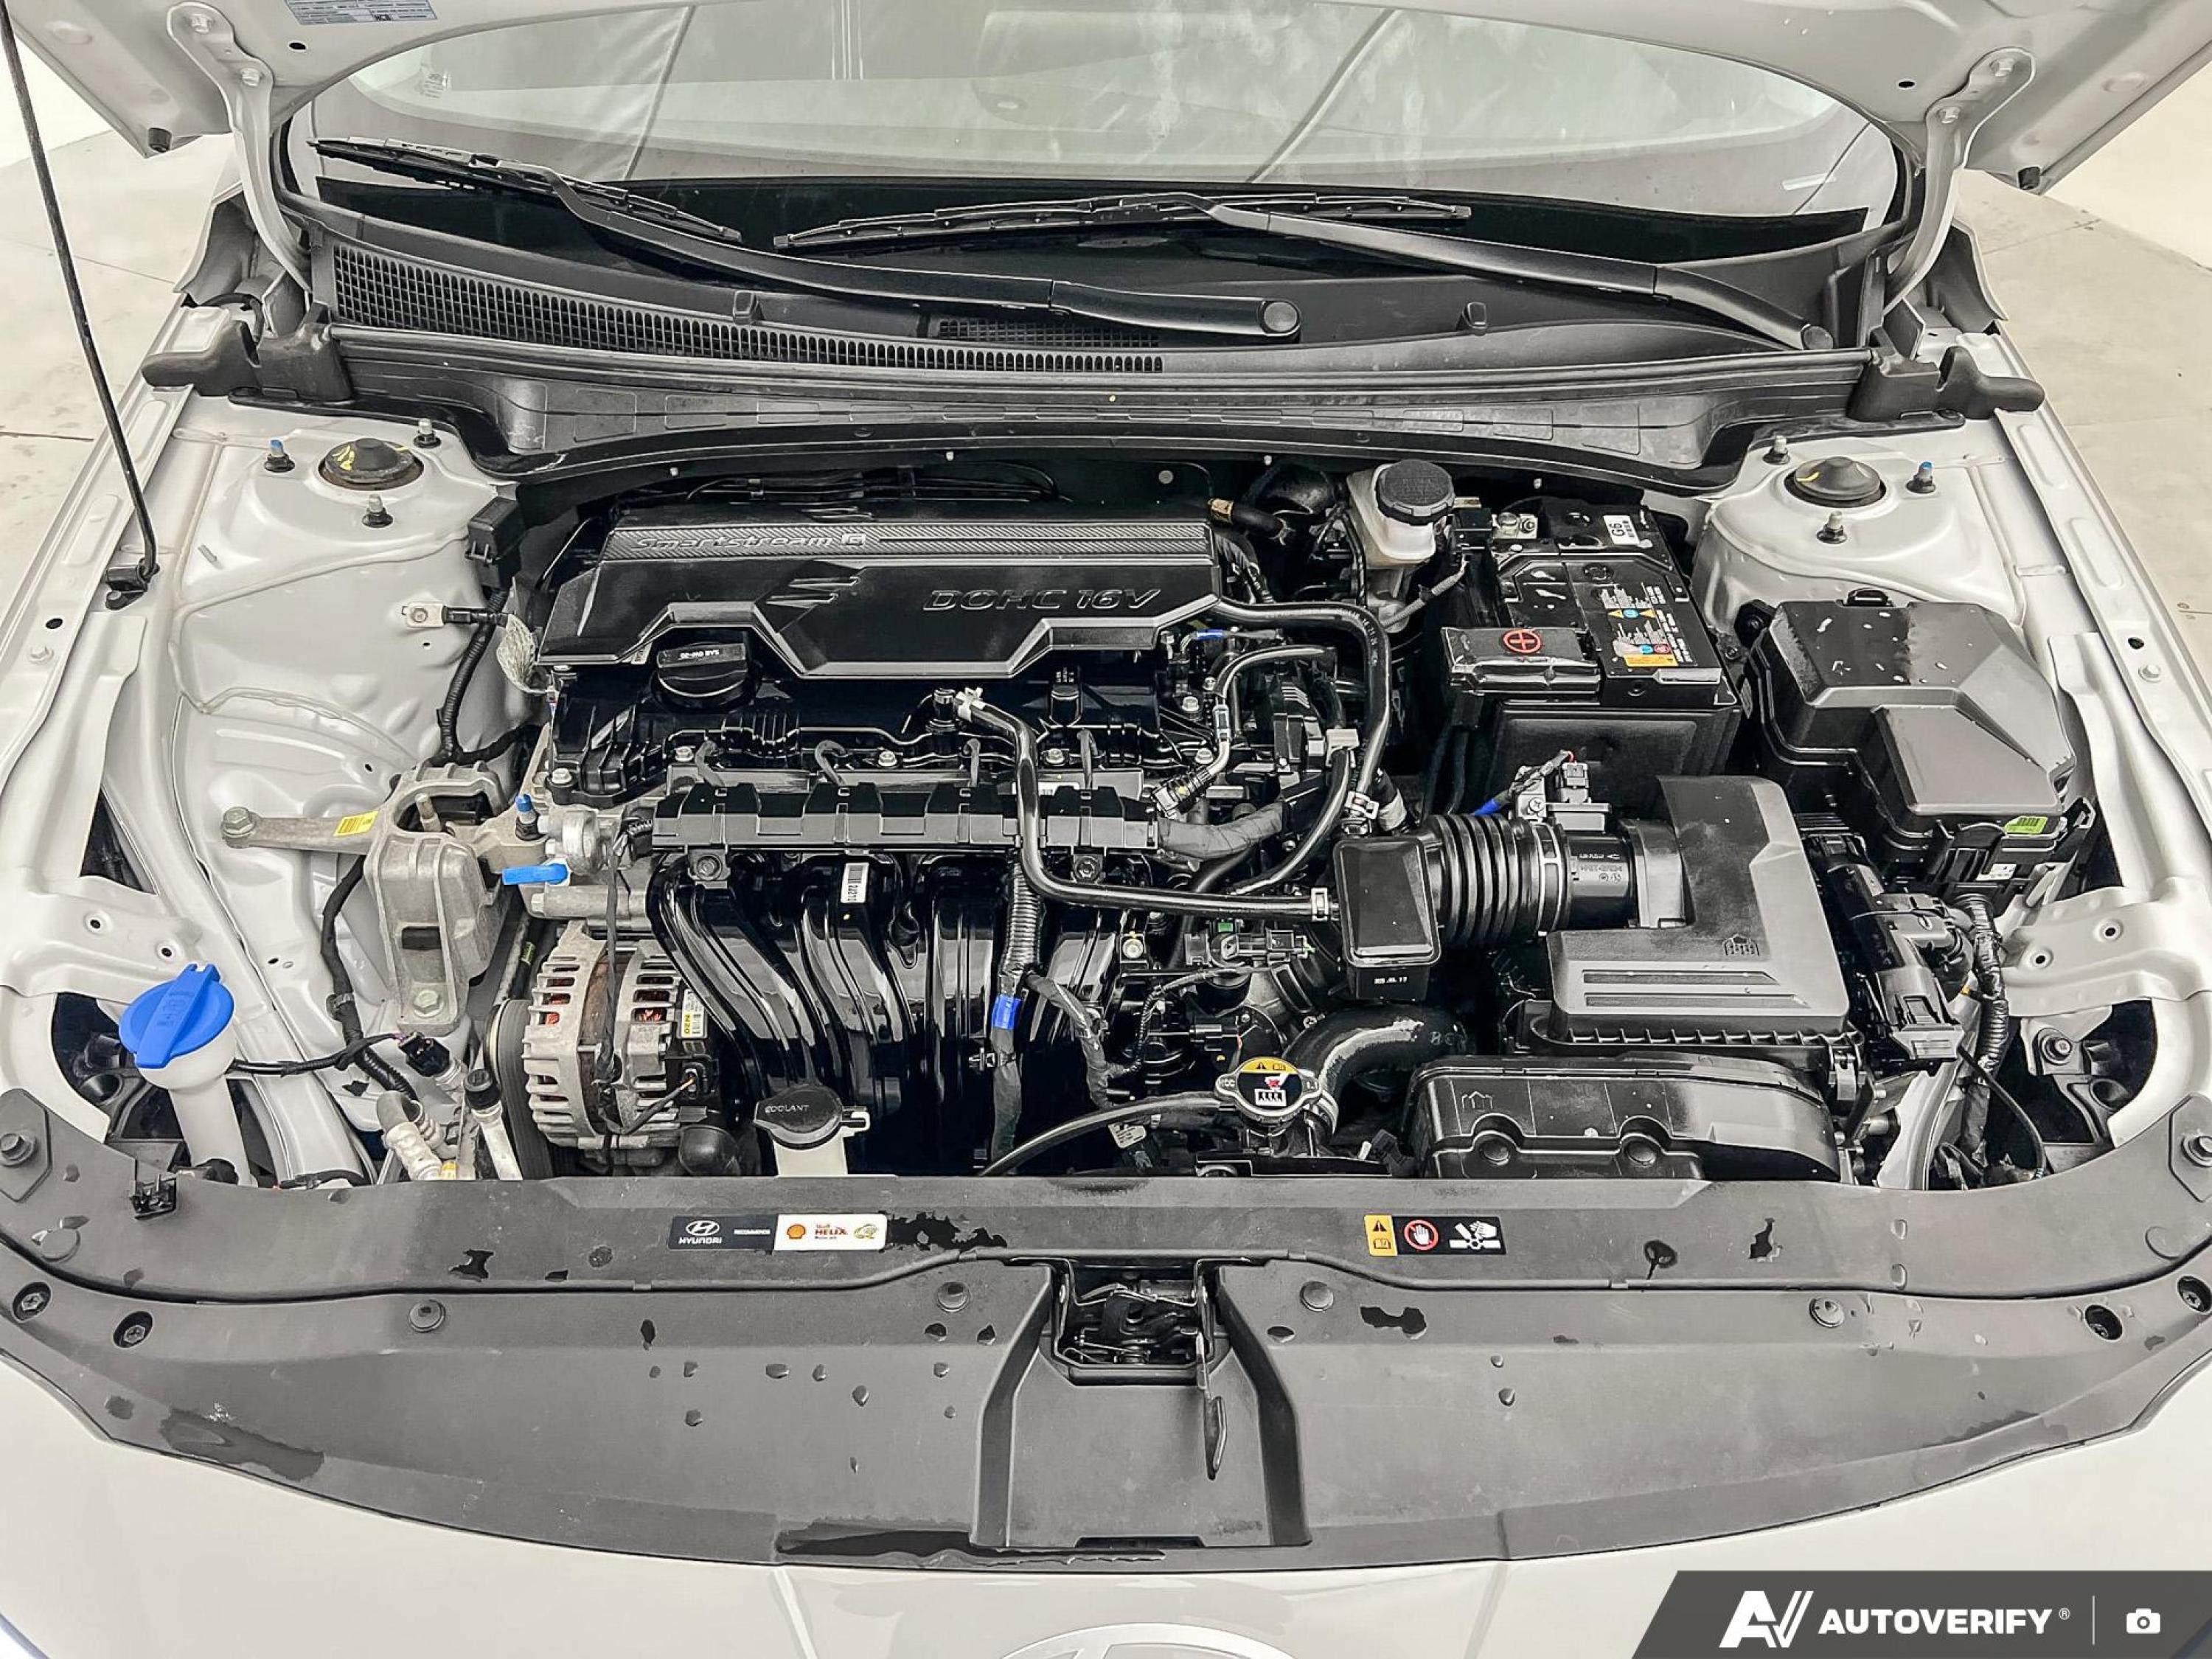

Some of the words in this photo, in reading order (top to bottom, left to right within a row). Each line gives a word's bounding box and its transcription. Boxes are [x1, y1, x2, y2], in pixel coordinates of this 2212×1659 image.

[630, 535, 832, 550] Smartstream
[923, 589, 1067, 611] DOHC
[1077, 589, 1162, 609] 16V
[765, 1105, 810, 1114] COOLANT
[814, 1227, 849, 1236] HELIX
[678, 1237, 723, 1245] HYUNDAI
